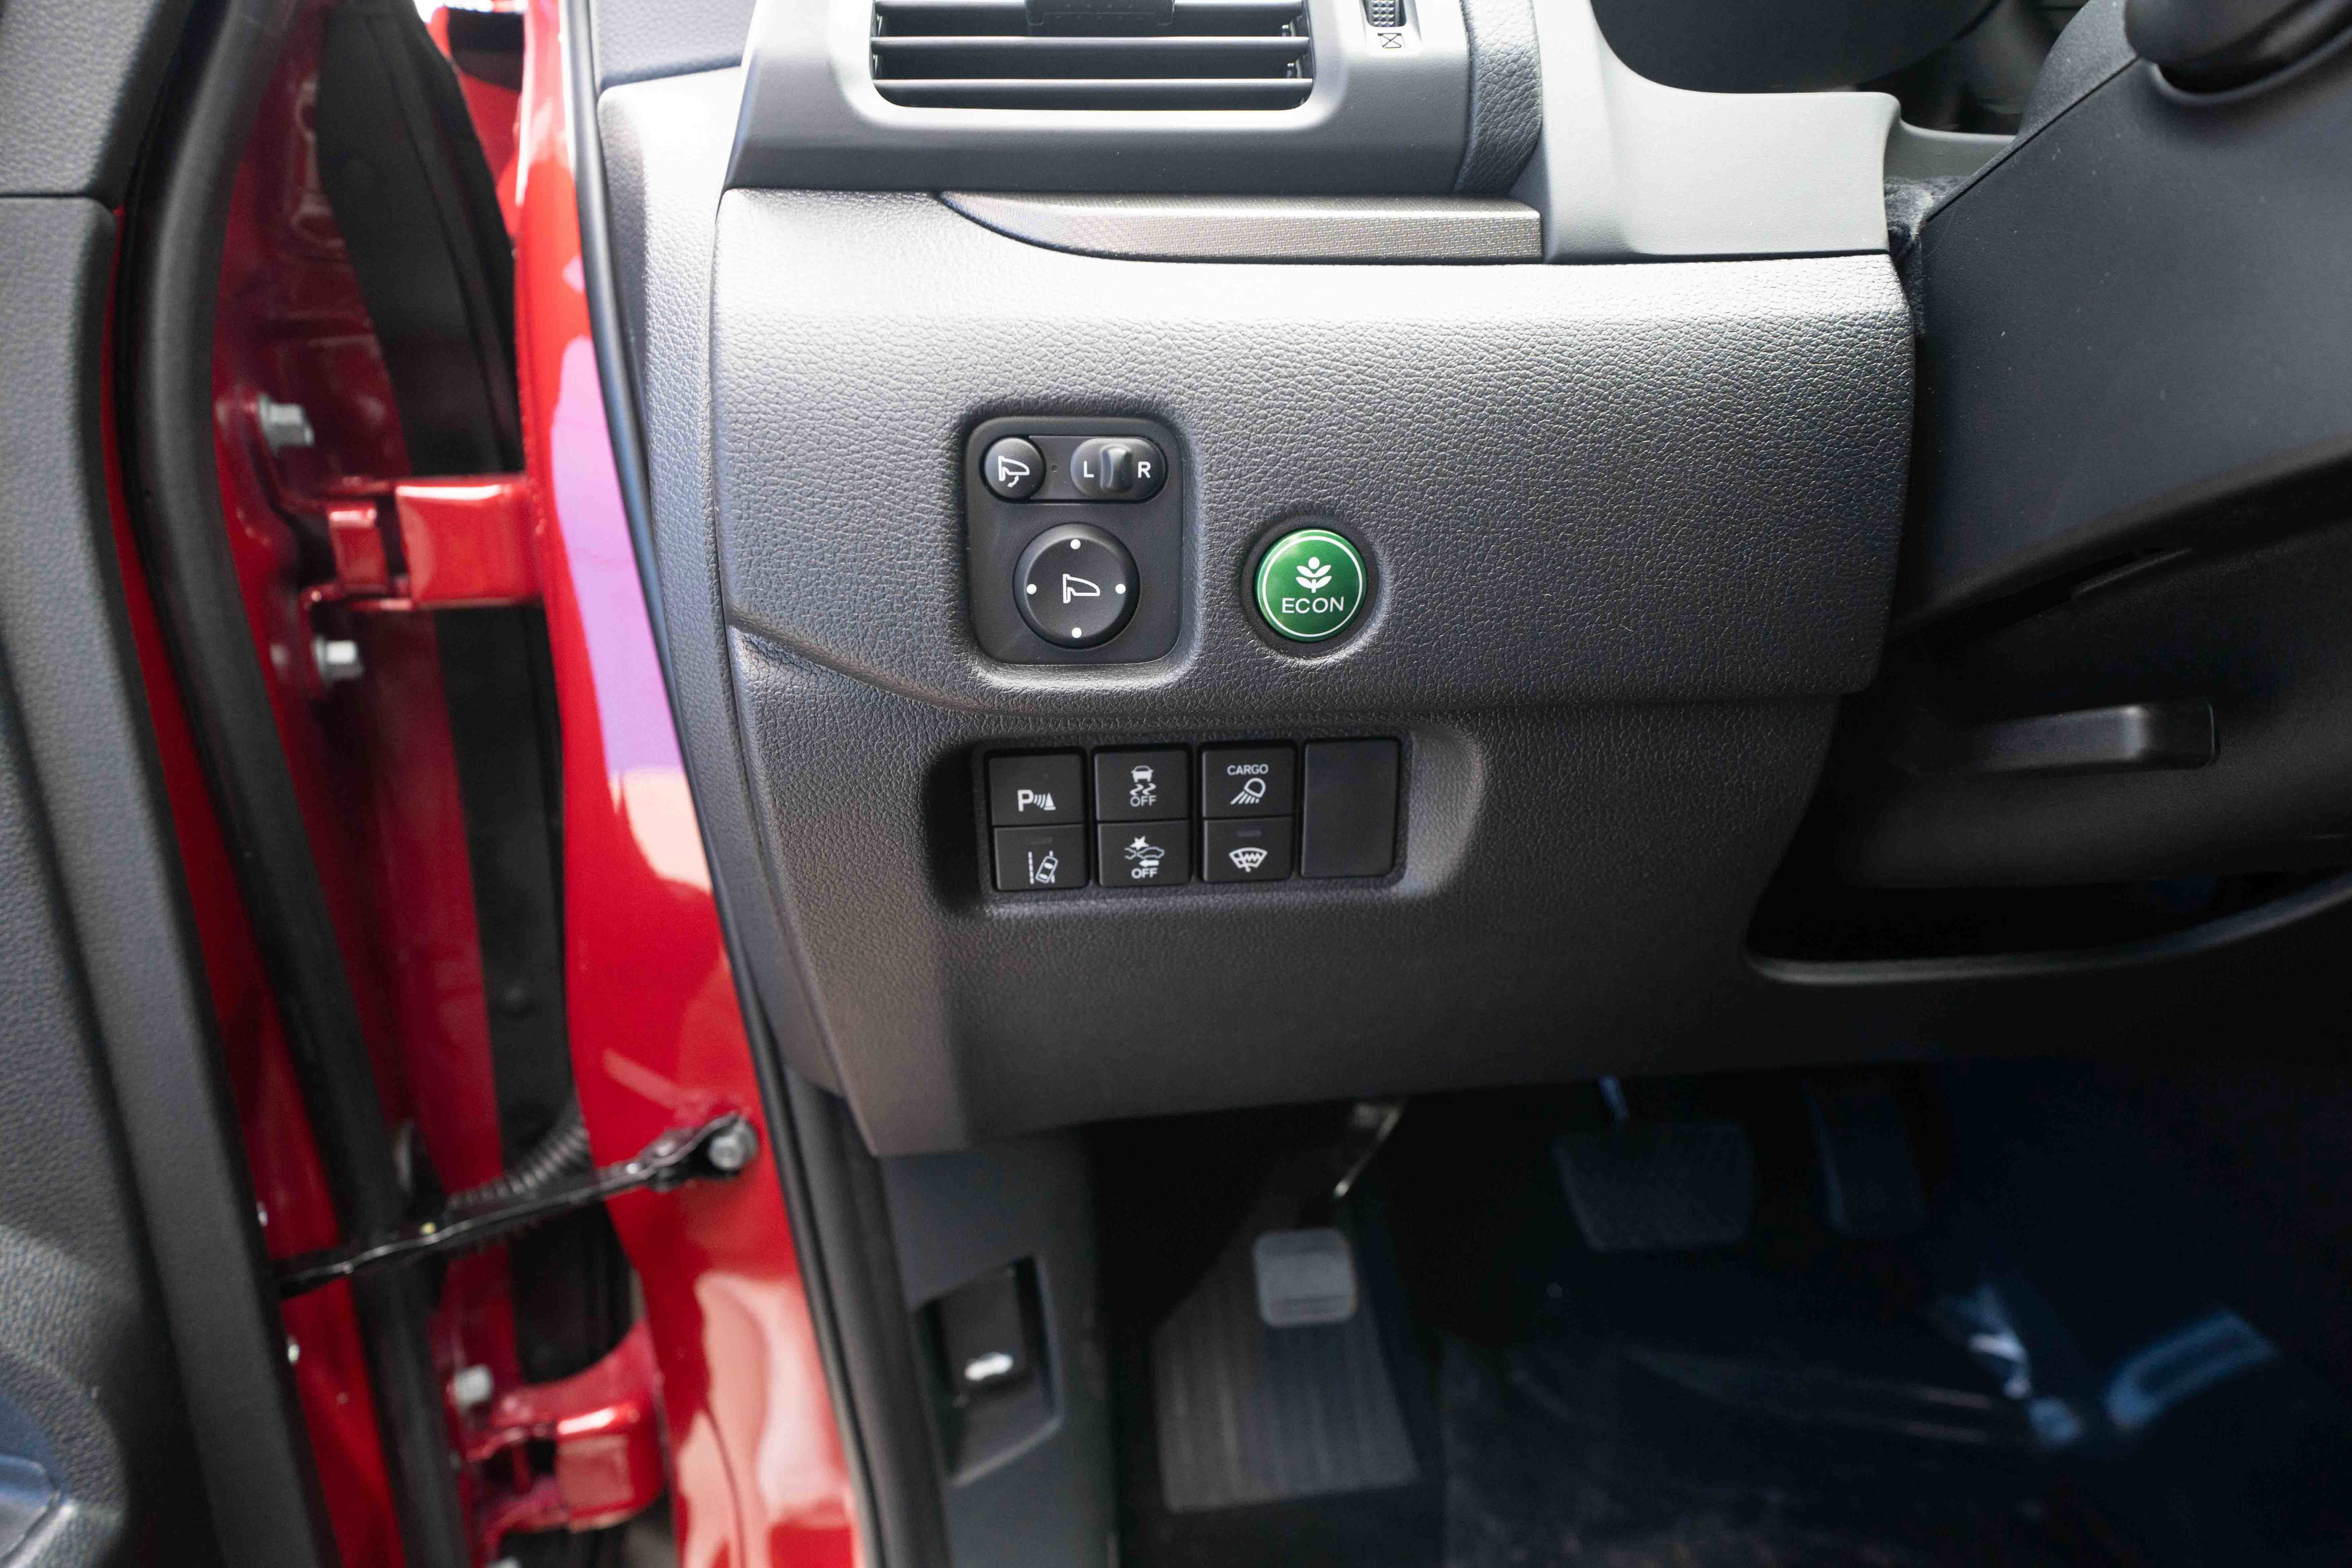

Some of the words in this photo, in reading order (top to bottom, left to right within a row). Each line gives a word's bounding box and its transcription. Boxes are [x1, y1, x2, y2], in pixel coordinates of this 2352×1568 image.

[1083, 460, 1095, 478] L
[1137, 461, 1151, 479] R
[1281, 596, 1344, 614] ECON
[1227, 764, 1269, 776] CARGO
[1017, 789, 1033, 812] P
[1129, 795, 1157, 807] OFF
[1131, 867, 1158, 880] OFF
